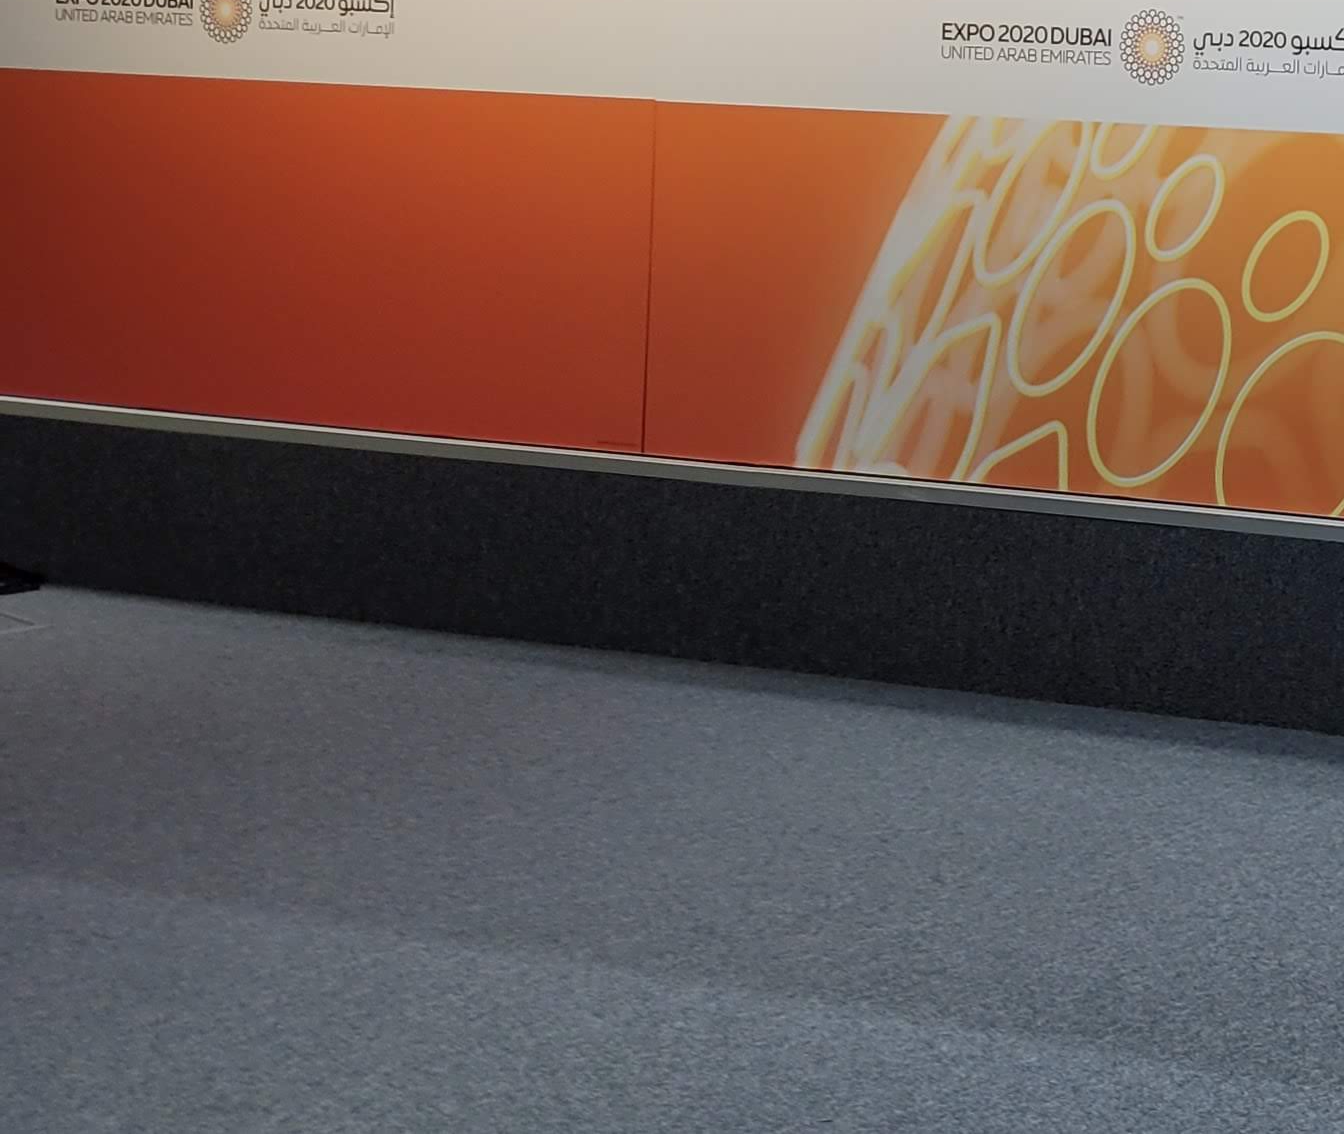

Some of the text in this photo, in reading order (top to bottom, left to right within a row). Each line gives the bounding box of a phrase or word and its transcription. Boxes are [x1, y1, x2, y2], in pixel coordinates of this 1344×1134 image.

[56, 8, 192, 26] UNITED ARAB EMIRATES
[942, 23, 1111, 46] EXPO 2020 DUBAI
[1239, 30, 1286, 48] 2020
[1194, 33, 1233, 55] دبي
[942, 46, 1111, 65] UNITED ARAB EMIRATES
[1193, 57, 1241, 71] المتحدة
[1246, 59, 1299, 76] العربية
